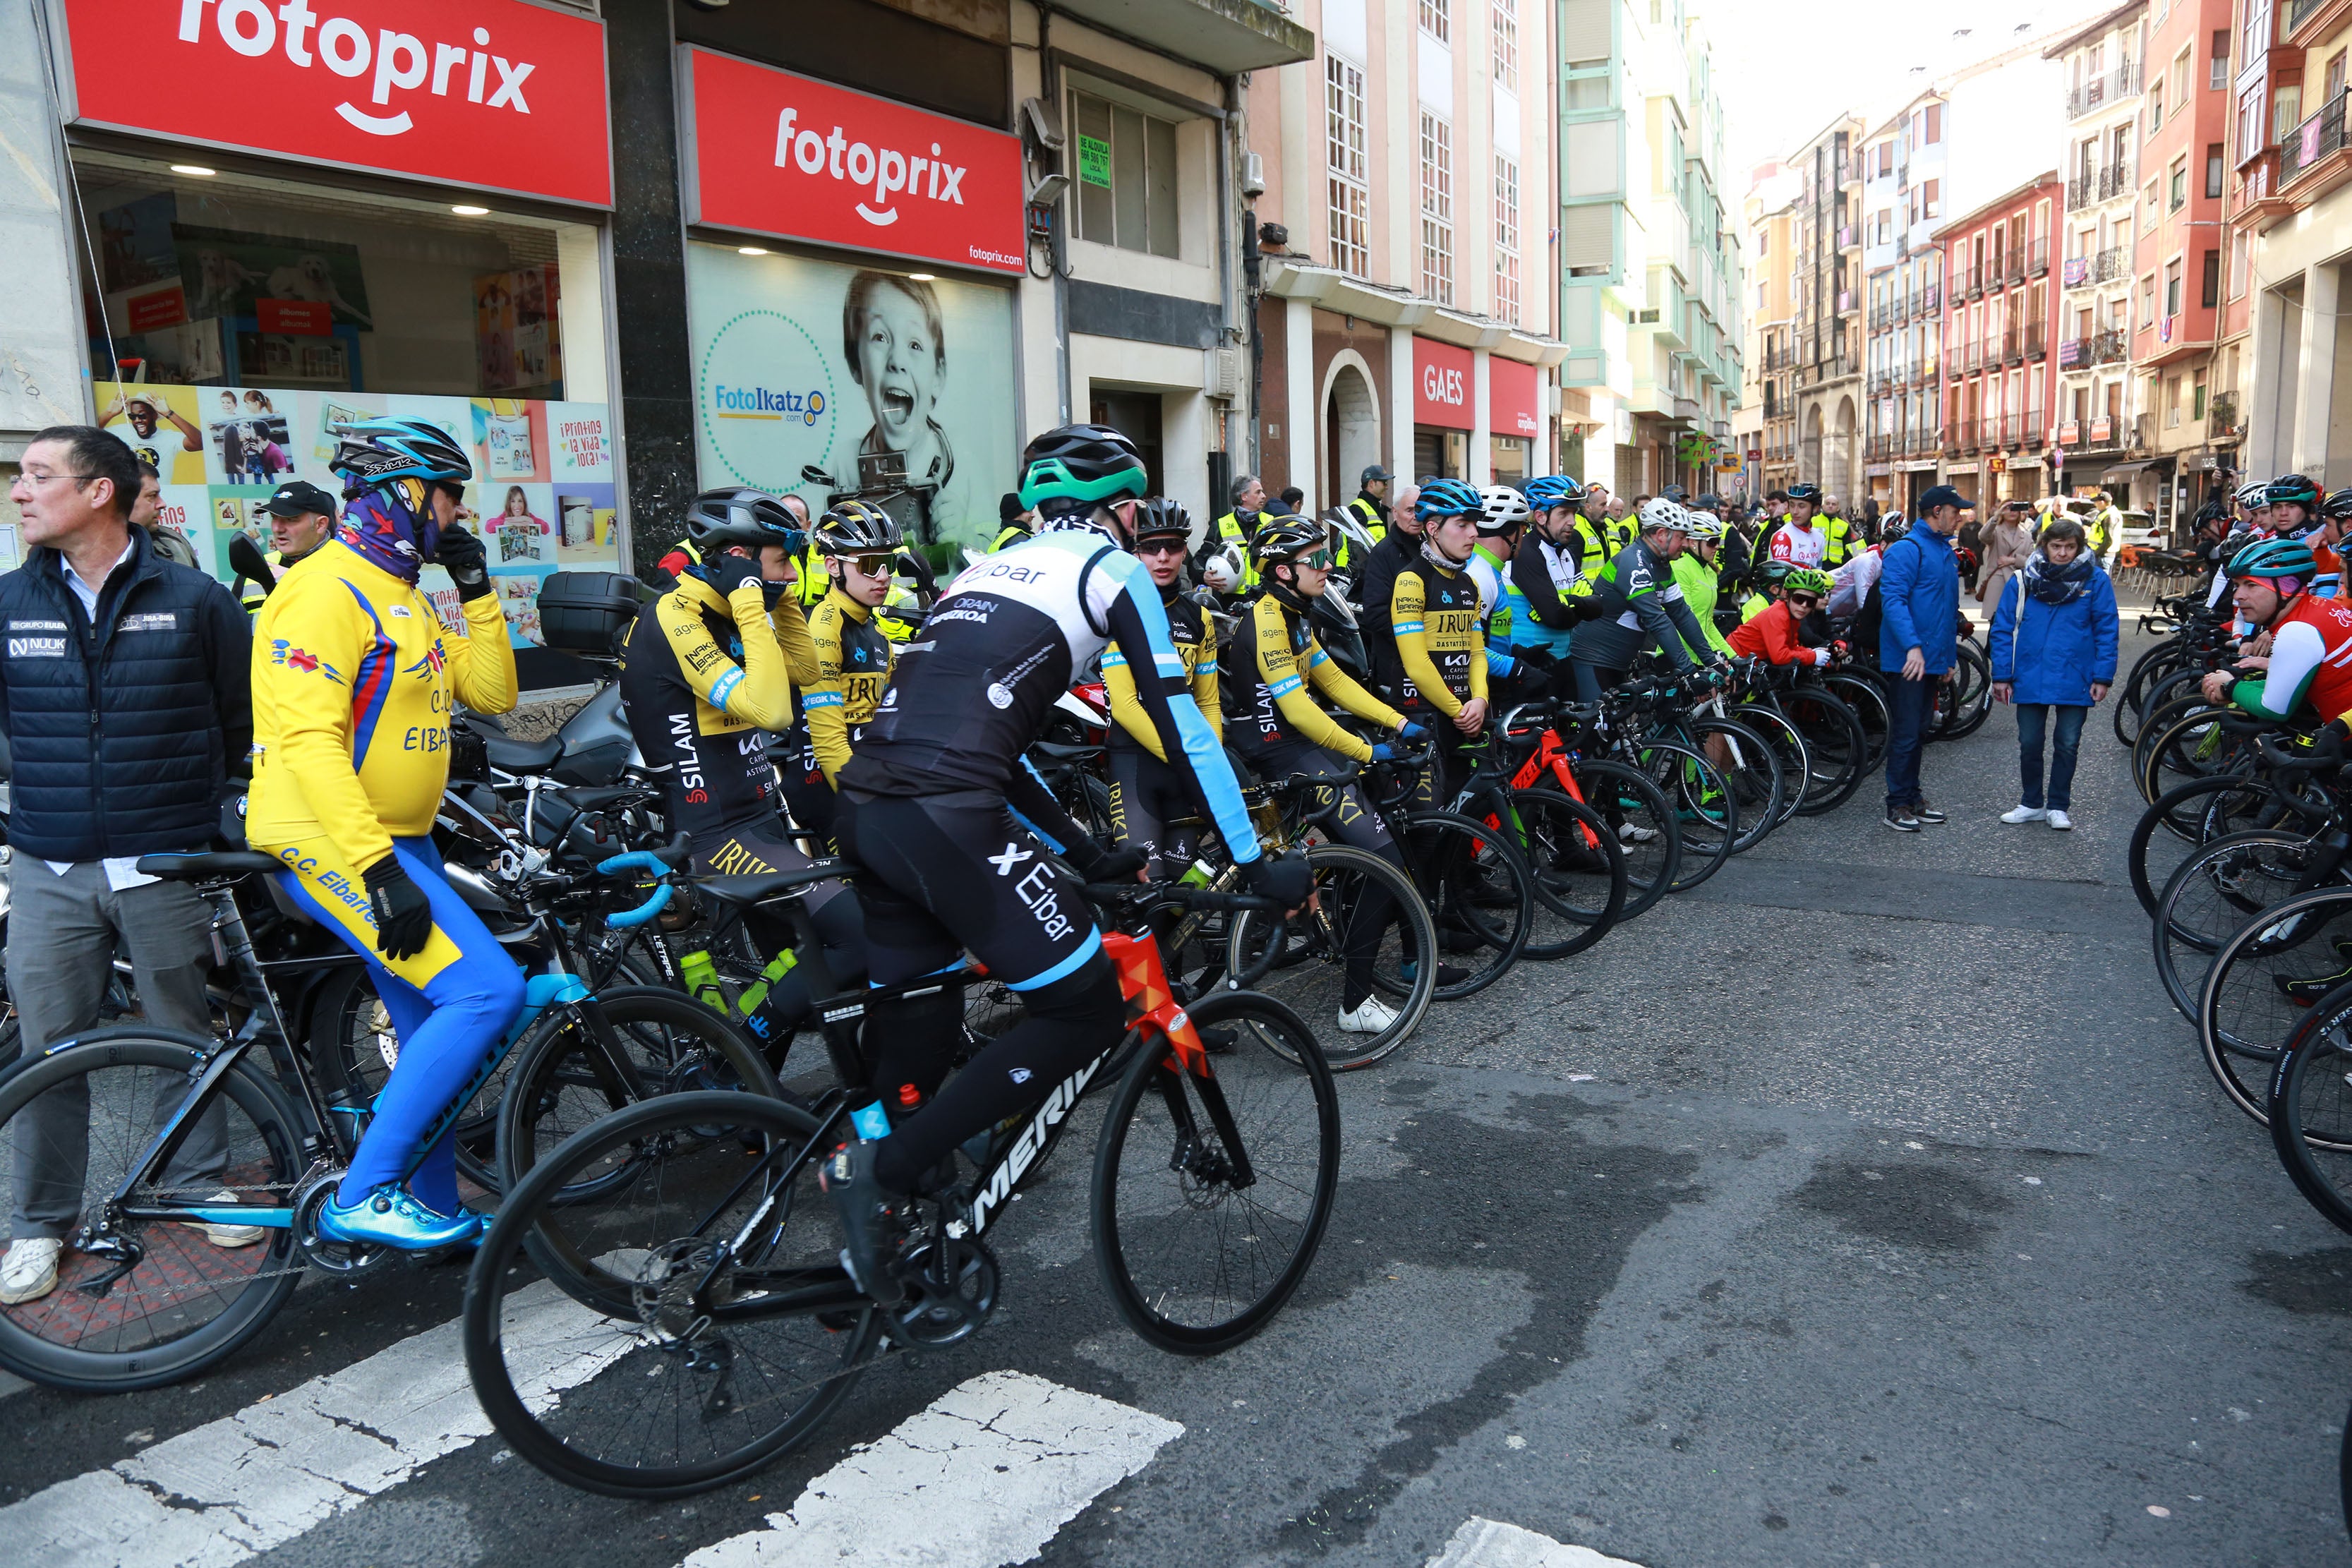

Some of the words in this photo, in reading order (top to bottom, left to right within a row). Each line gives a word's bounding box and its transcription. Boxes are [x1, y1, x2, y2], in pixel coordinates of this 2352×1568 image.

[774, 107, 967, 205] fotoprix
[1088, 140, 1108, 154] ALQUILA
[969, 245, 1023, 267] fotoprix.com
[716, 385, 803, 412] FotoIkatz
[1424, 364, 1464, 406] GAES
[2260, 554, 2283, 565] LAZER
[1255, 683, 1278, 733] SILAM
[668, 713, 704, 789] SILAM
[1109, 780, 1129, 843] IRUKI
[281, 847, 317, 874] C.C.
[1164, 850, 1192, 861] David
[1015, 862, 1075, 941] Eibar
